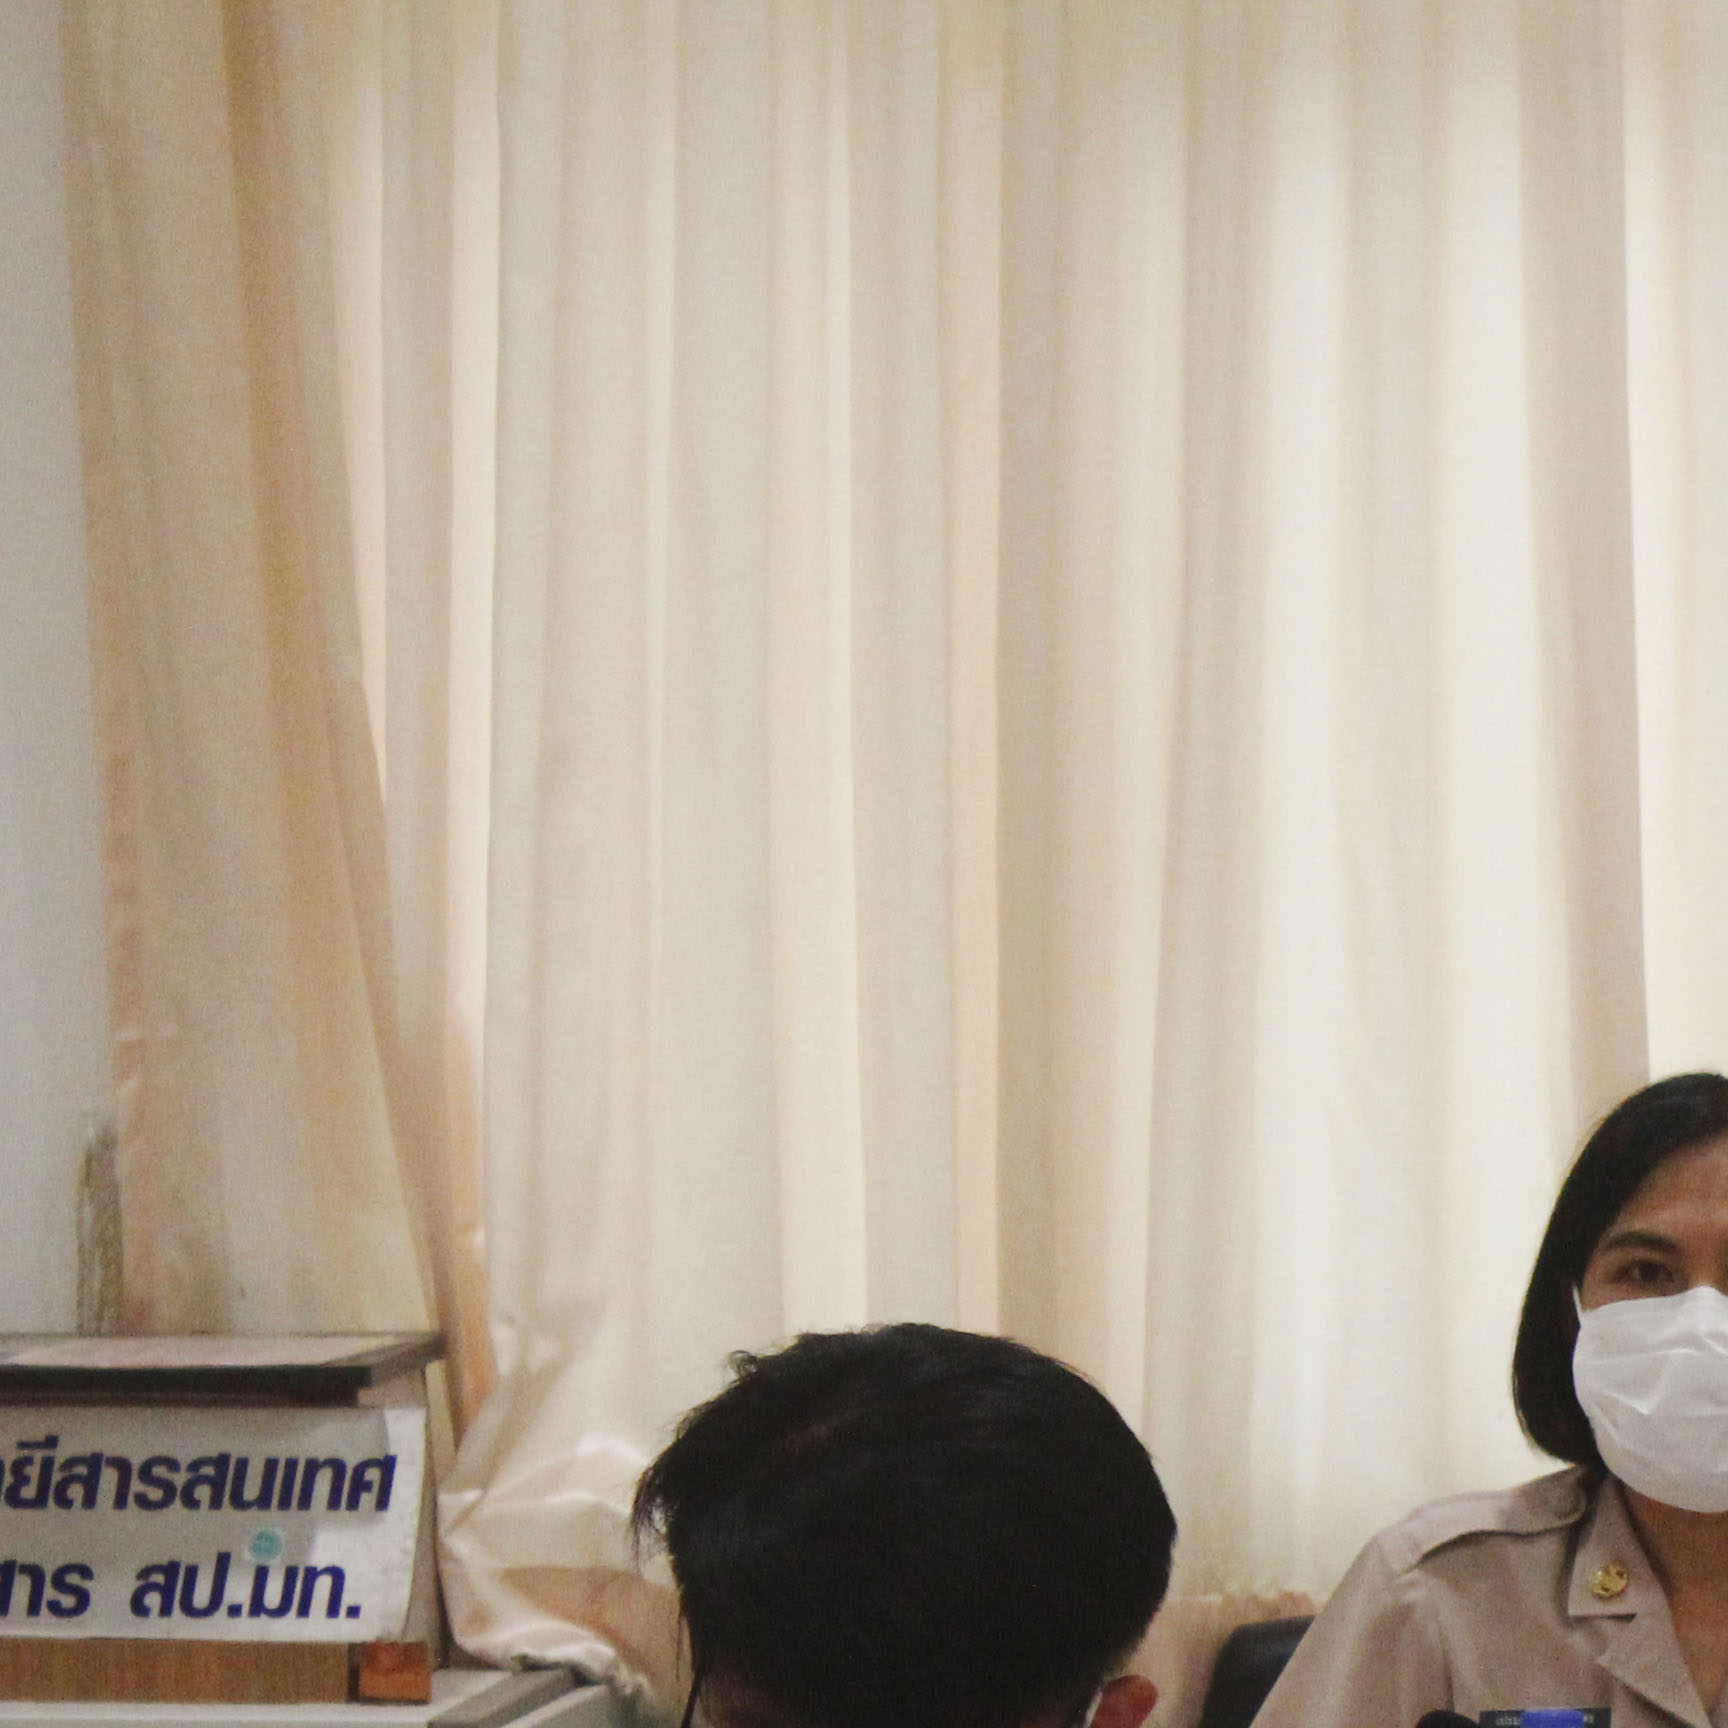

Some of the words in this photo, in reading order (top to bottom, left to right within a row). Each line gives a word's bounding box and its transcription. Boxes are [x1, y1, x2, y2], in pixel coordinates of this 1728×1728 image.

[0, 1433, 397, 1511] ยีสารสนเทศ
[130, 1551, 362, 1619] สป.มท.
